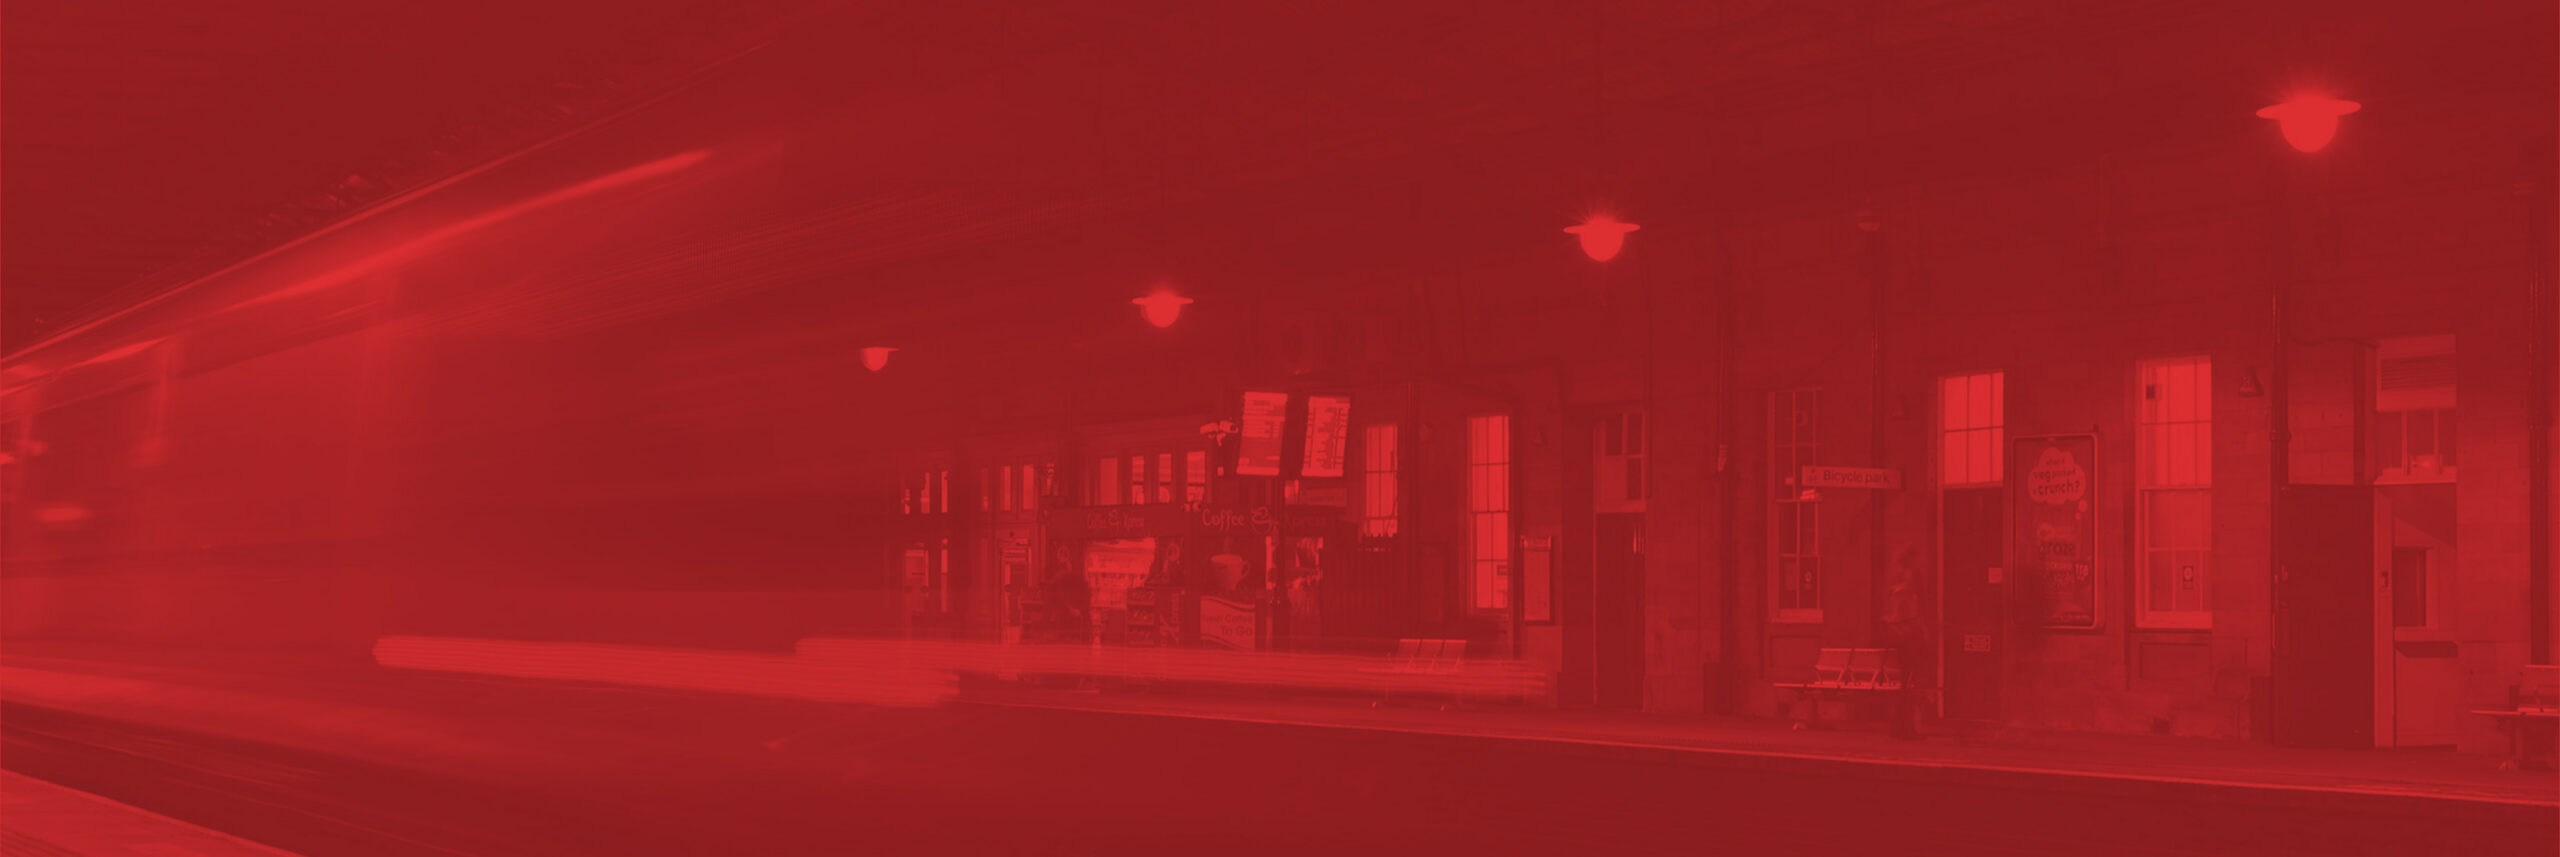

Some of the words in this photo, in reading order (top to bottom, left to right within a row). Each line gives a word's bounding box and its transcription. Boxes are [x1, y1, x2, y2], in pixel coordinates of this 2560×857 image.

[1823, 470, 1863, 484] Bicycle
[1865, 471, 1891, 484] park
[2038, 479, 2081, 495] crunch?
[1201, 508, 1246, 533] Coffee
[1221, 625, 1233, 636] To
[1235, 625, 1253, 636] Go
